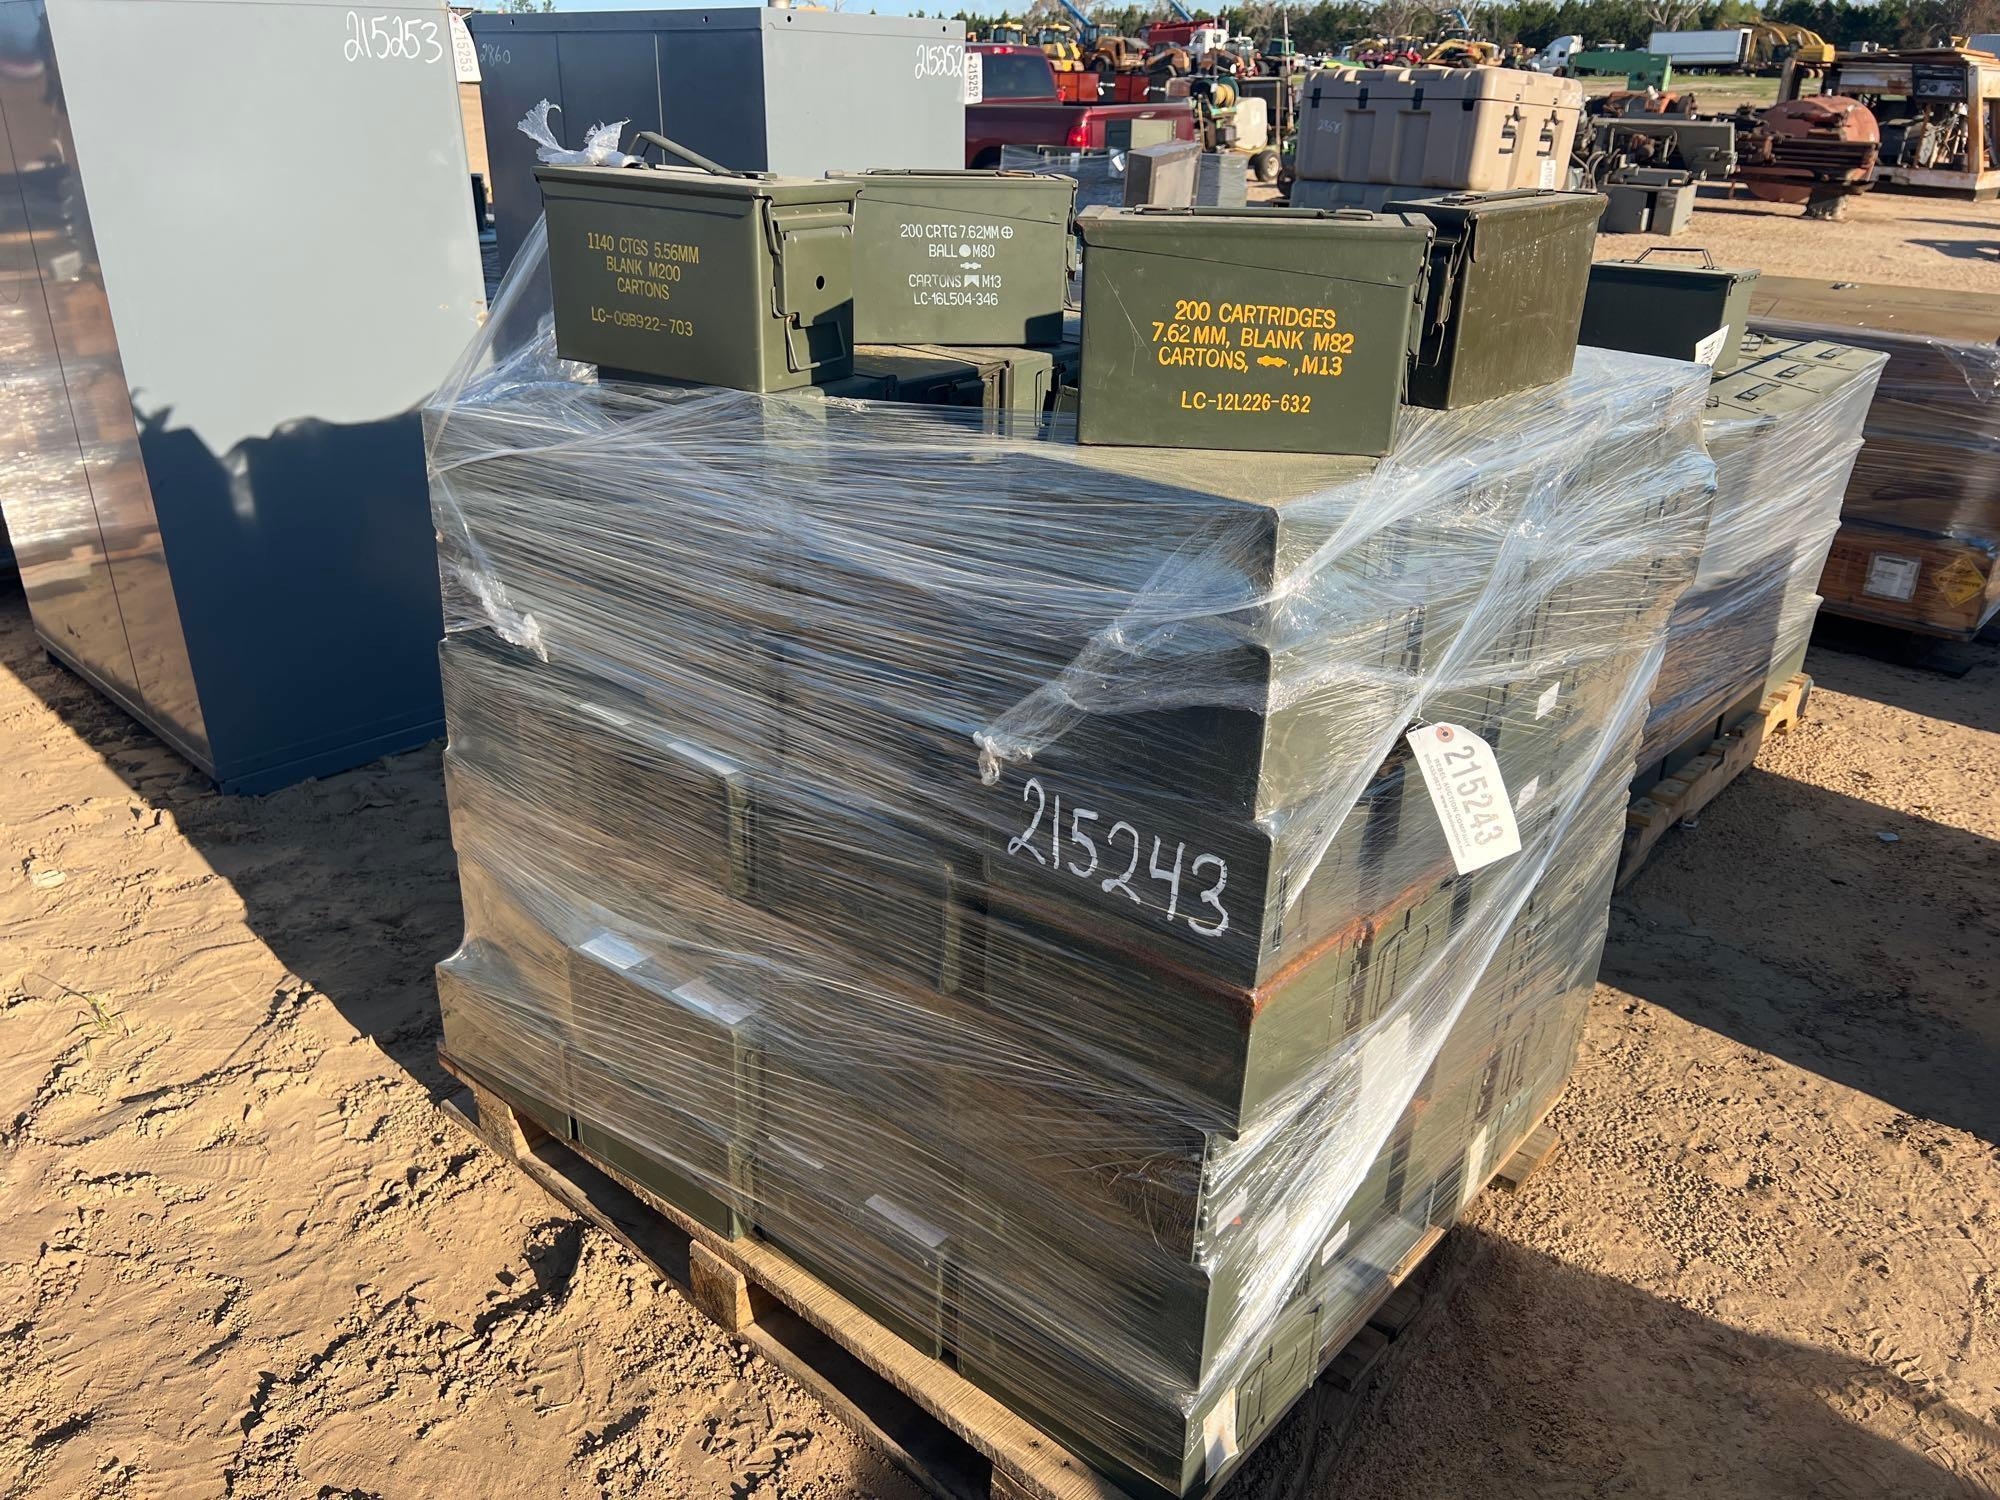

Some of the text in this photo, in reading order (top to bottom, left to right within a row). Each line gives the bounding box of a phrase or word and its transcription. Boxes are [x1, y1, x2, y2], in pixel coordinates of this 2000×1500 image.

[344, 11, 443, 64] 215253
[453, 27, 473, 73] 215253
[479, 42, 511, 66] 2860
[915, 44, 964, 79] 215252
[968, 63, 979, 98] 215252
[900, 224, 1000, 239] 200 CRTG 7.62MM
[587, 232, 700, 264] 1140 CTGS 5.56MM
[928, 244, 996, 258] BALL M80
[606, 255, 681, 282] BLANK M200
[908, 273, 1002, 289] CARTONS M13
[616, 277, 670, 300] CARTONS
[913, 292, 999, 306] LC-16L504-346
[591, 305, 694, 337] LC-09B922-703
[1174, 299, 1337, 330] 200 CARTRIDGES
[1240, 327, 1305, 351] BLANK
[1313, 332, 1356, 354] M82
[1158, 346, 1250, 374] CARTONS,
[1181, 390, 1312, 414] LC-12L226-632
[1433, 757, 1471, 847] REBEL AUCTION COMPANY
[1443, 744, 1504, 846] 215243
[1007, 777, 1229, 937] 215243
